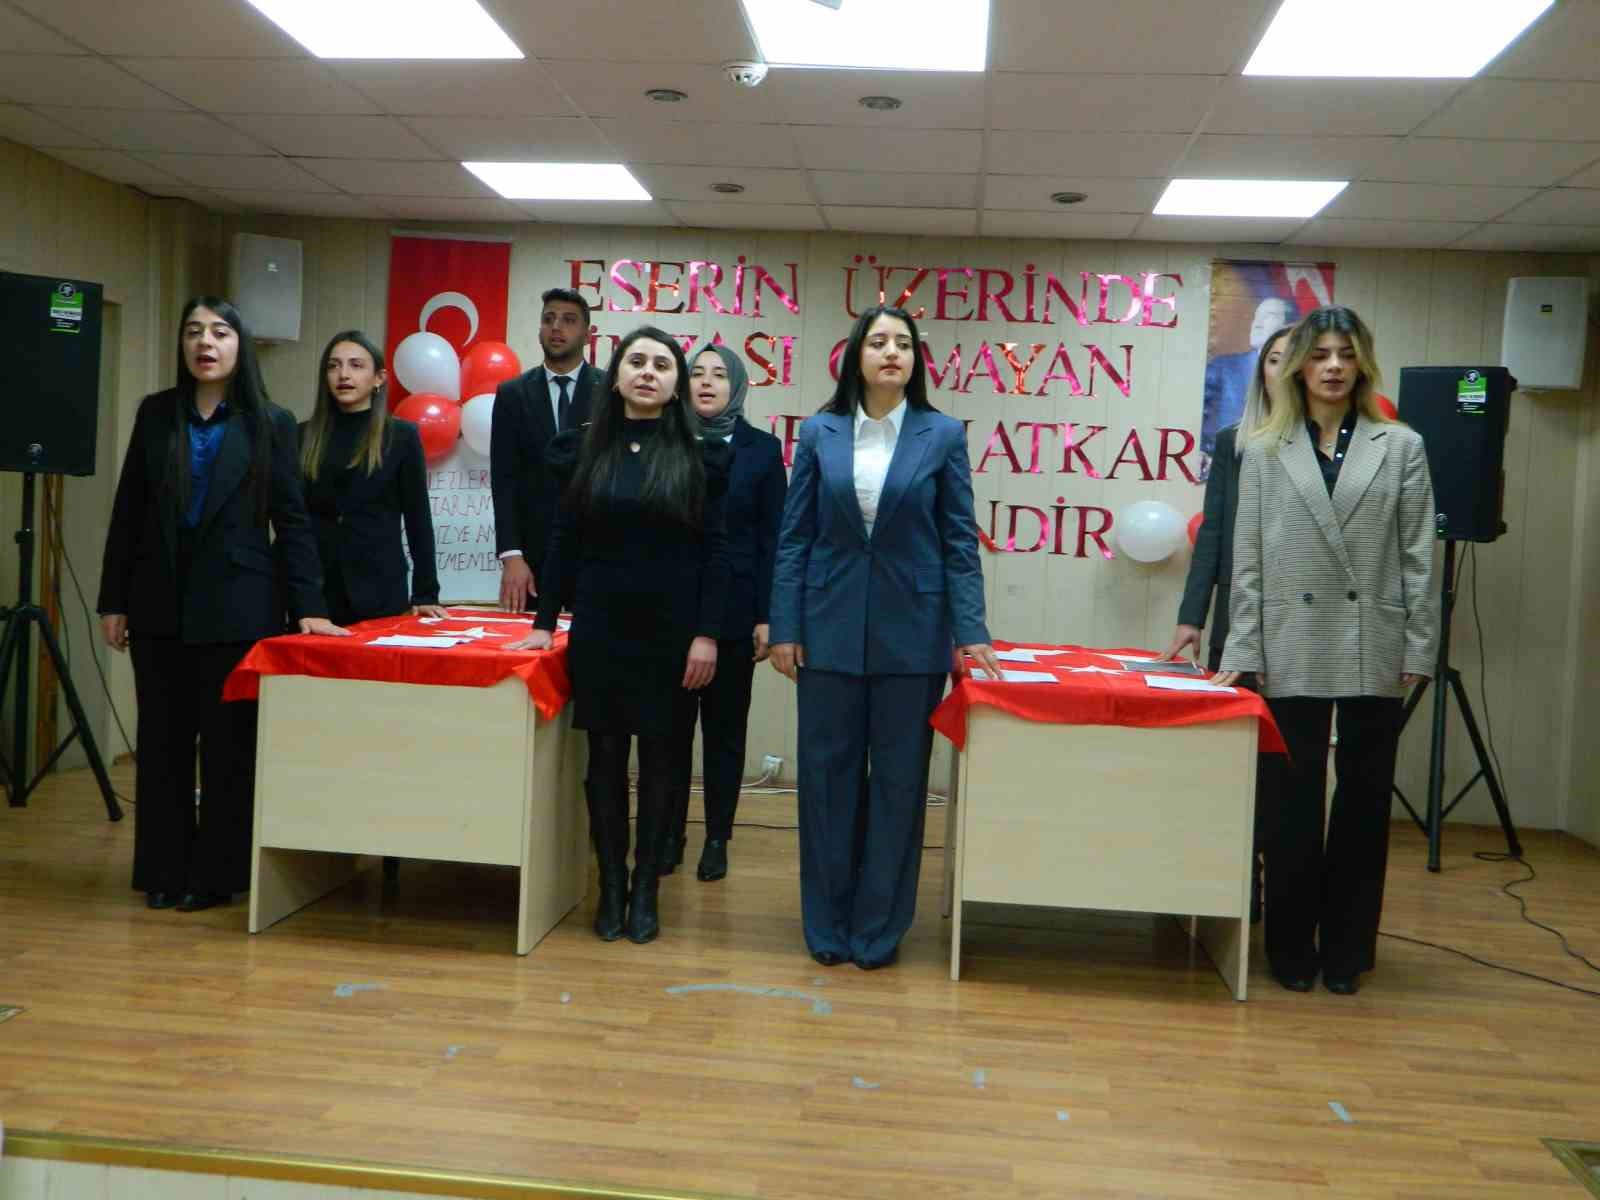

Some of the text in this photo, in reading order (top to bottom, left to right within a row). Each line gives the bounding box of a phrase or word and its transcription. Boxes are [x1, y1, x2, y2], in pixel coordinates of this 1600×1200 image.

[565, 255, 1184, 329] ESERİN ÜZERİNDE
[829, 337, 1134, 398] MAYAN
[963, 419, 1207, 486] ATKAR
